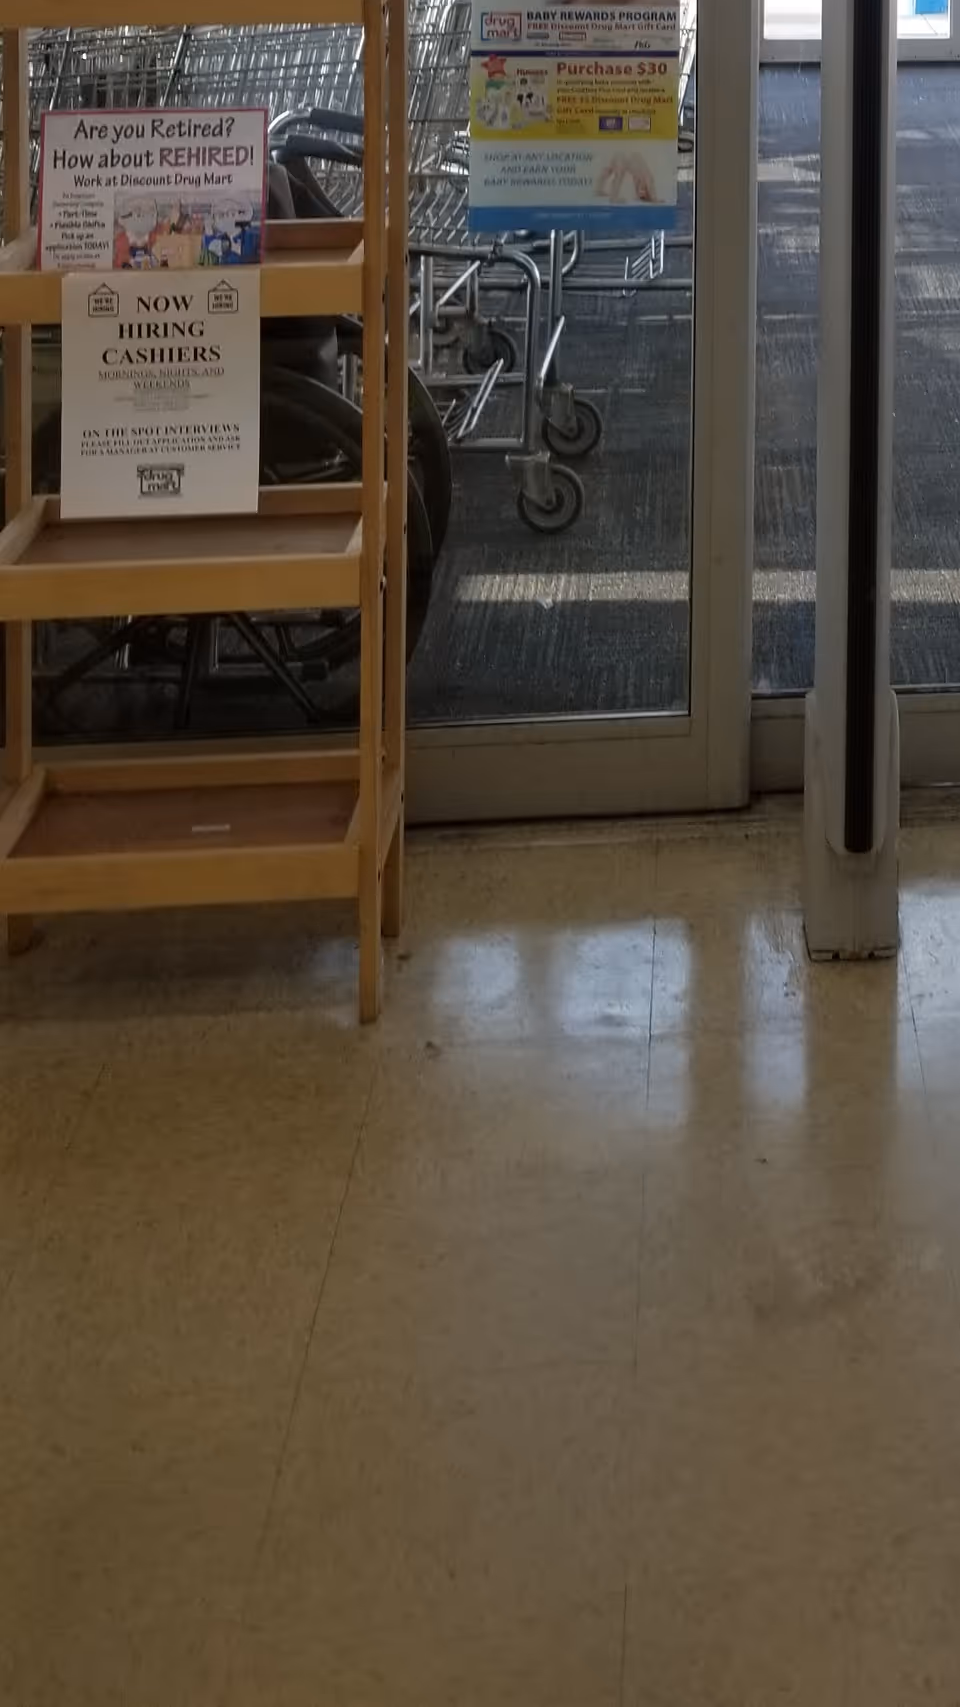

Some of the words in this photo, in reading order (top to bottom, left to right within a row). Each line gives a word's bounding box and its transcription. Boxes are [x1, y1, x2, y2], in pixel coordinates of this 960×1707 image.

[484, 12, 516, 27] drug
[527, 11, 557, 21] BABY
[560, 11, 617, 21] REWARDS
[619, 11, 677, 22] PROGRAM
[486, 25, 519, 37] mart
[527, 22, 550, 31] FREE
[550, 22, 591, 31] Discount
[614, 22, 636, 31] Mart
[655, 22, 676, 31] Card
[556, 61, 633, 76] Purchase
[636, 61, 668, 76] $30
[73, 119, 108, 140] Are
[111, 124, 145, 143] you
[150, 116, 236, 139] Retired?
[53, 149, 94, 170] How
[99, 149, 155, 168] about
[159, 145, 255, 168] REHIRED!
[73, 174, 103, 187] Work
[105, 175, 118, 187] at
[120, 174, 173, 187] Discount
[174, 174, 201, 188] Drug
[203, 173, 233, 185] Mart
[135, 294, 194, 314] NOW
[118, 320, 205, 340] HIRING
[102, 344, 222, 366] CASHIERS
[83, 429, 103, 439] ON
[105, 428, 128, 438] THE
[131, 426, 161, 437] SPOT
[164, 423, 240, 436] INTERVIEWS
[143, 469, 174, 482] drug
